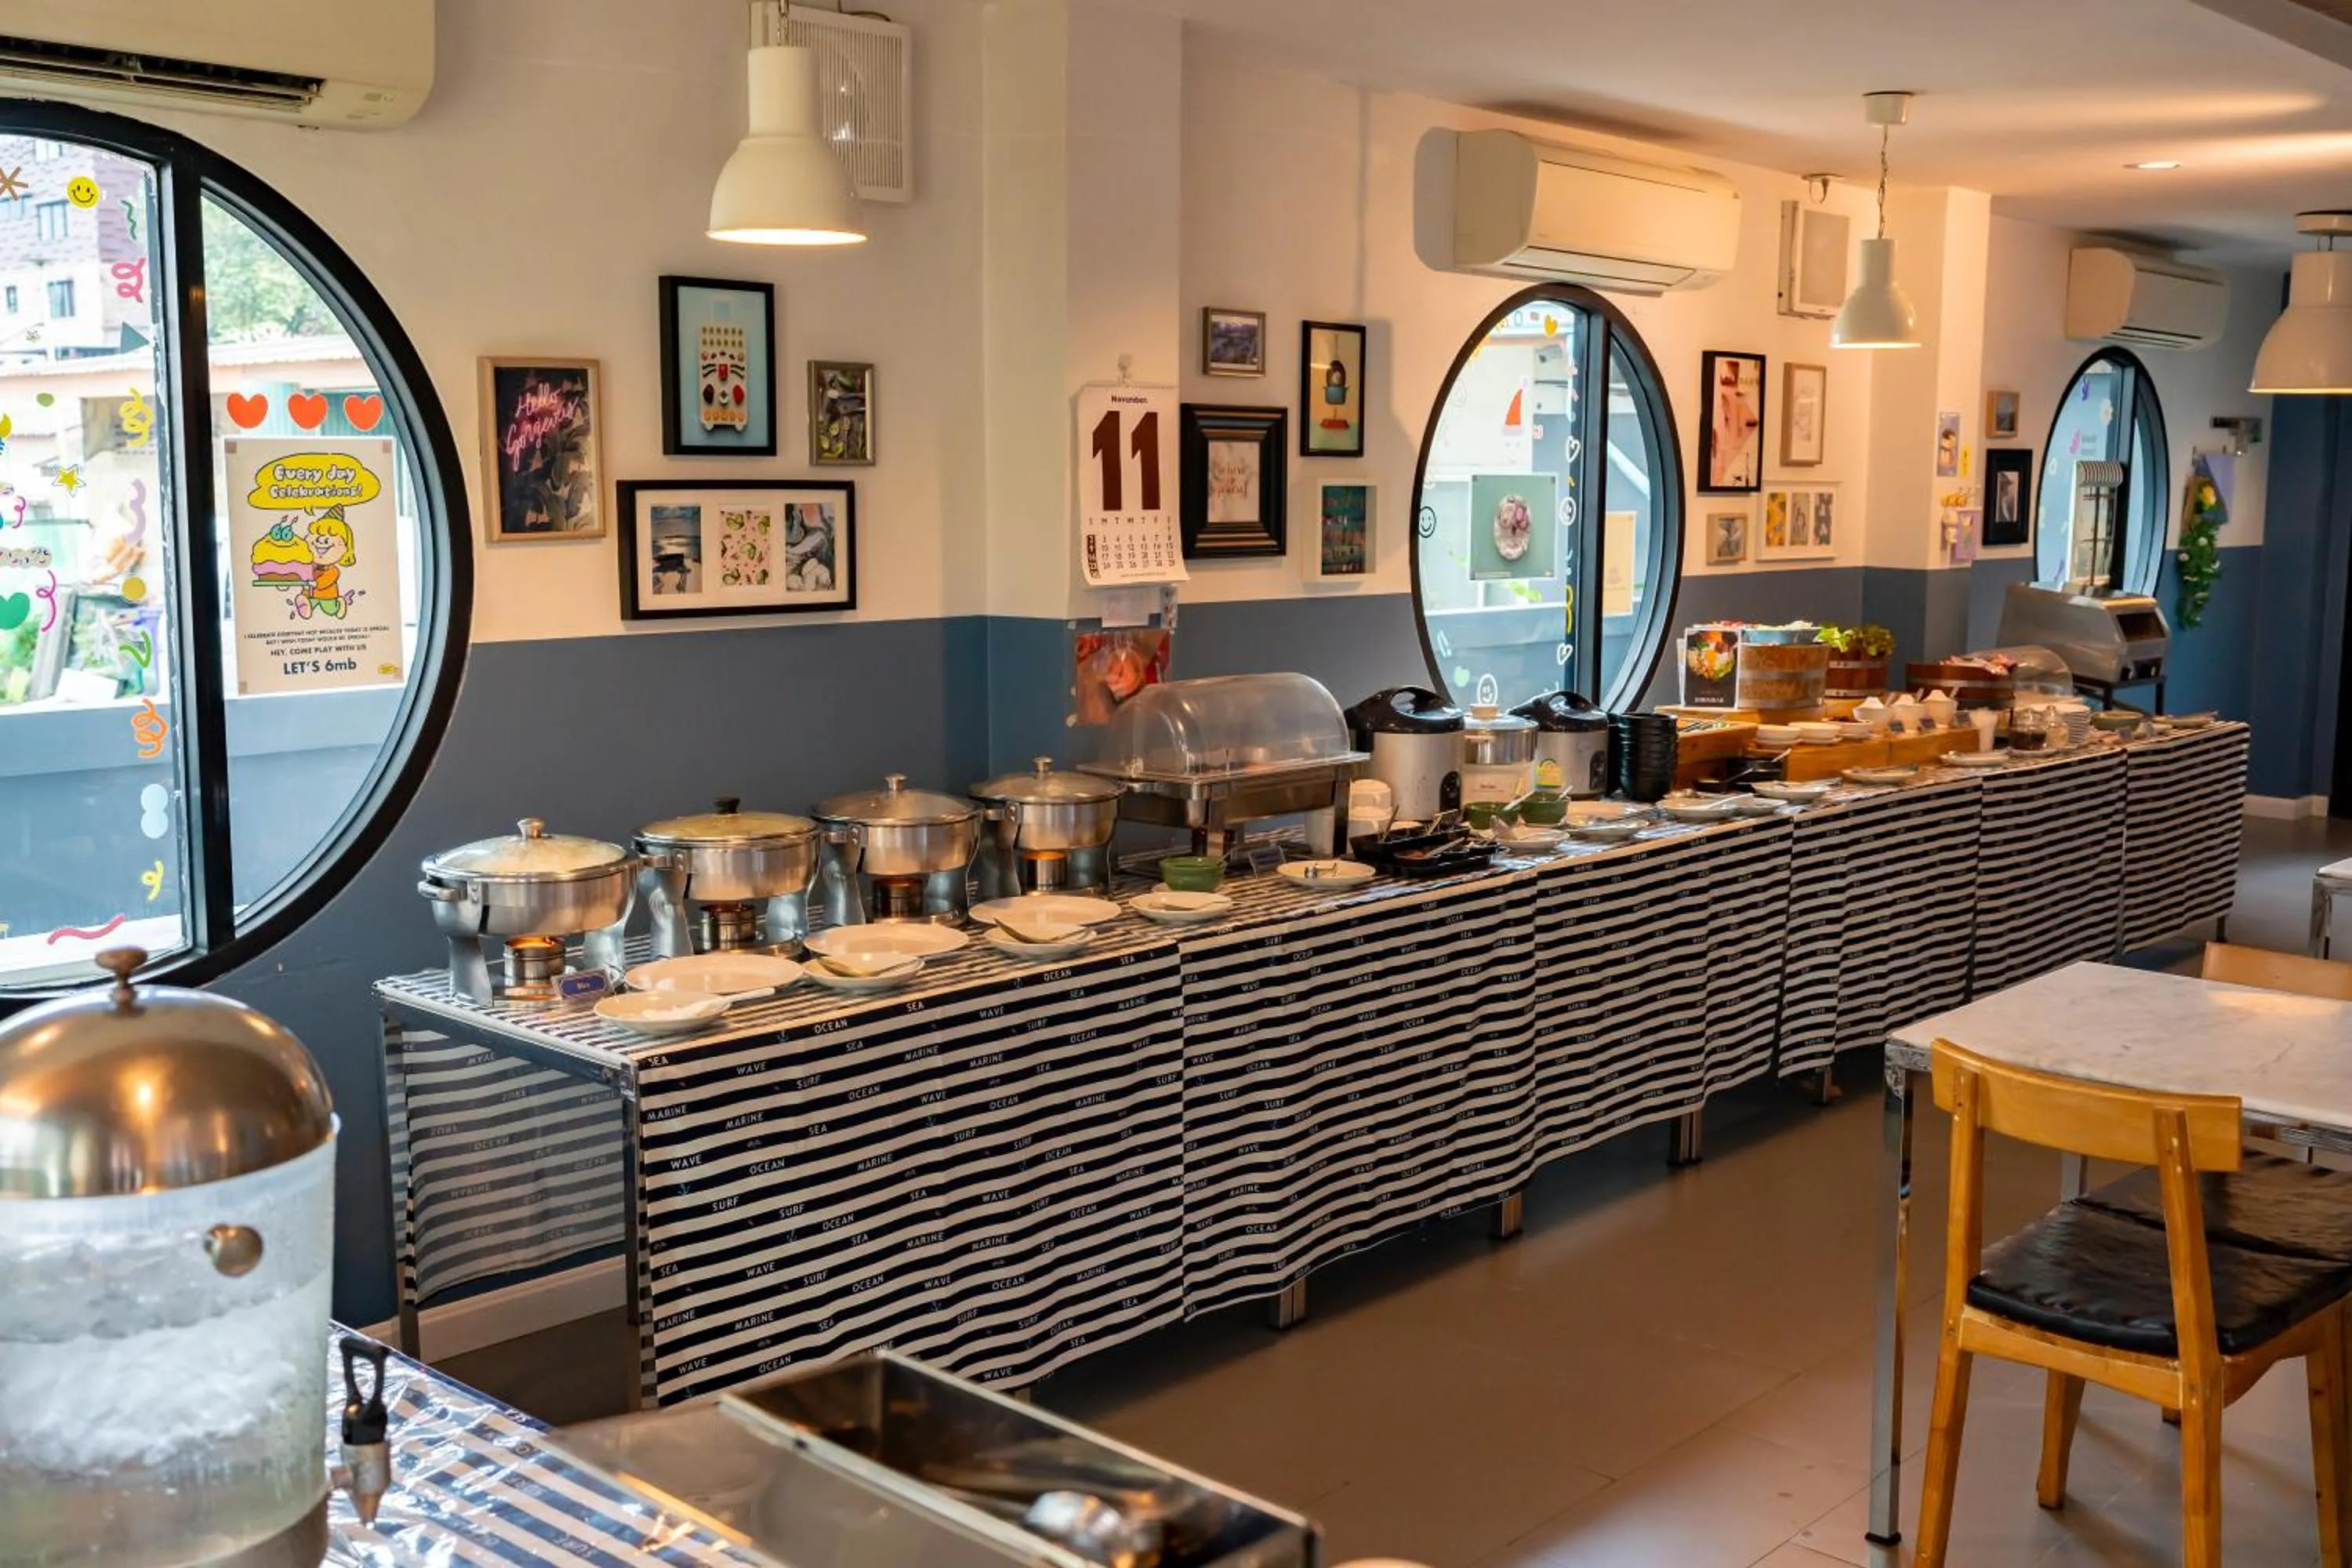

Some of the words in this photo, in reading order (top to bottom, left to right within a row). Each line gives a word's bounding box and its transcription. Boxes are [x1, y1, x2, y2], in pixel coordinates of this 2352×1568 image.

[515, 383, 561, 418] Hello
[1092, 410, 1161, 512] 11
[273, 463, 322, 483] Every
[326, 463, 356, 482] day
[270, 485, 363, 499] Celebrations!
[314, 645, 332, 654] PLAY
[283, 660, 321, 675] LET'S
[325, 657, 358, 672] 6mb
[1044, 969, 1072, 982] OCEAN
[906, 1001, 924, 1011] SEA
[979, 1007, 1004, 1018] WAVE
[814, 1019, 848, 1033] OCEAN
[1070, 1030, 1097, 1043] OCEAN
[846, 1041, 864, 1051] SEA
[904, 1046, 939, 1061] MARINE
[1192, 1054, 1214, 1065] WAVE
[648, 1056, 670, 1066] SEA
[970, 1054, 1003, 1067] MARINE
[736, 1062, 766, 1074] WAVE
[796, 1075, 821, 1088] SURF
[1156, 1074, 1177, 1085] SURF
[848, 1085, 880, 1100] OCEAN
[920, 1091, 946, 1103] WAVE
[989, 1096, 1018, 1109] OCEAN
[1075, 1094, 1106, 1107] MARINE
[1264, 1099, 1285, 1109] SURF
[647, 1105, 687, 1120] MARINE
[725, 1112, 764, 1129] MARINE
[808, 1124, 827, 1135] SEA
[953, 1129, 977, 1142] SURF
[1045, 1147, 1072, 1160] OCEAN
[1238, 1143, 1260, 1154] WAVE
[670, 1154, 702, 1169] WAVE
[749, 1159, 785, 1174] OCEAN
[857, 1154, 892, 1171] MARINE
[1069, 1166, 1084, 1175] SEA
[909, 1190, 927, 1201] SEA
[982, 1190, 1010, 1202] WAVE
[1229, 1185, 1261, 1197] MARINE
[712, 1196, 739, 1210] SURF
[1031, 1198, 1050, 1210] SURF
[779, 1204, 804, 1218] SURF
[1070, 1205, 1097, 1218] OCEAN
[1130, 1207, 1152, 1220] WAVE
[822, 1214, 854, 1229] OCEAN
[1246, 1224, 1278, 1233] OCEAN
[851, 1234, 869, 1245] SEA
[906, 1232, 945, 1248] MARINE
[971, 1236, 1008, 1250] MARINE
[1040, 1242, 1054, 1251] SEA
[660, 1264, 678, 1276] SEA
[746, 1262, 775, 1277] WAVE
[1076, 1265, 1105, 1281] MARINE
[803, 1270, 828, 1285] SURF
[852, 1275, 884, 1292] OCEAN
[924, 1276, 951, 1288] WAVE
[992, 1276, 1025, 1290] OCEAN
[658, 1309, 695, 1330] MARINE
[735, 1312, 774, 1330] MARINE
[957, 1309, 978, 1323] SURF
[1018, 1314, 1040, 1328] SURF
[1070, 1337, 1086, 1347] SEA
[678, 1358, 707, 1374] WAVE
[758, 1356, 791, 1373] OCEAN
[983, 1367, 1012, 1379] WAVE
